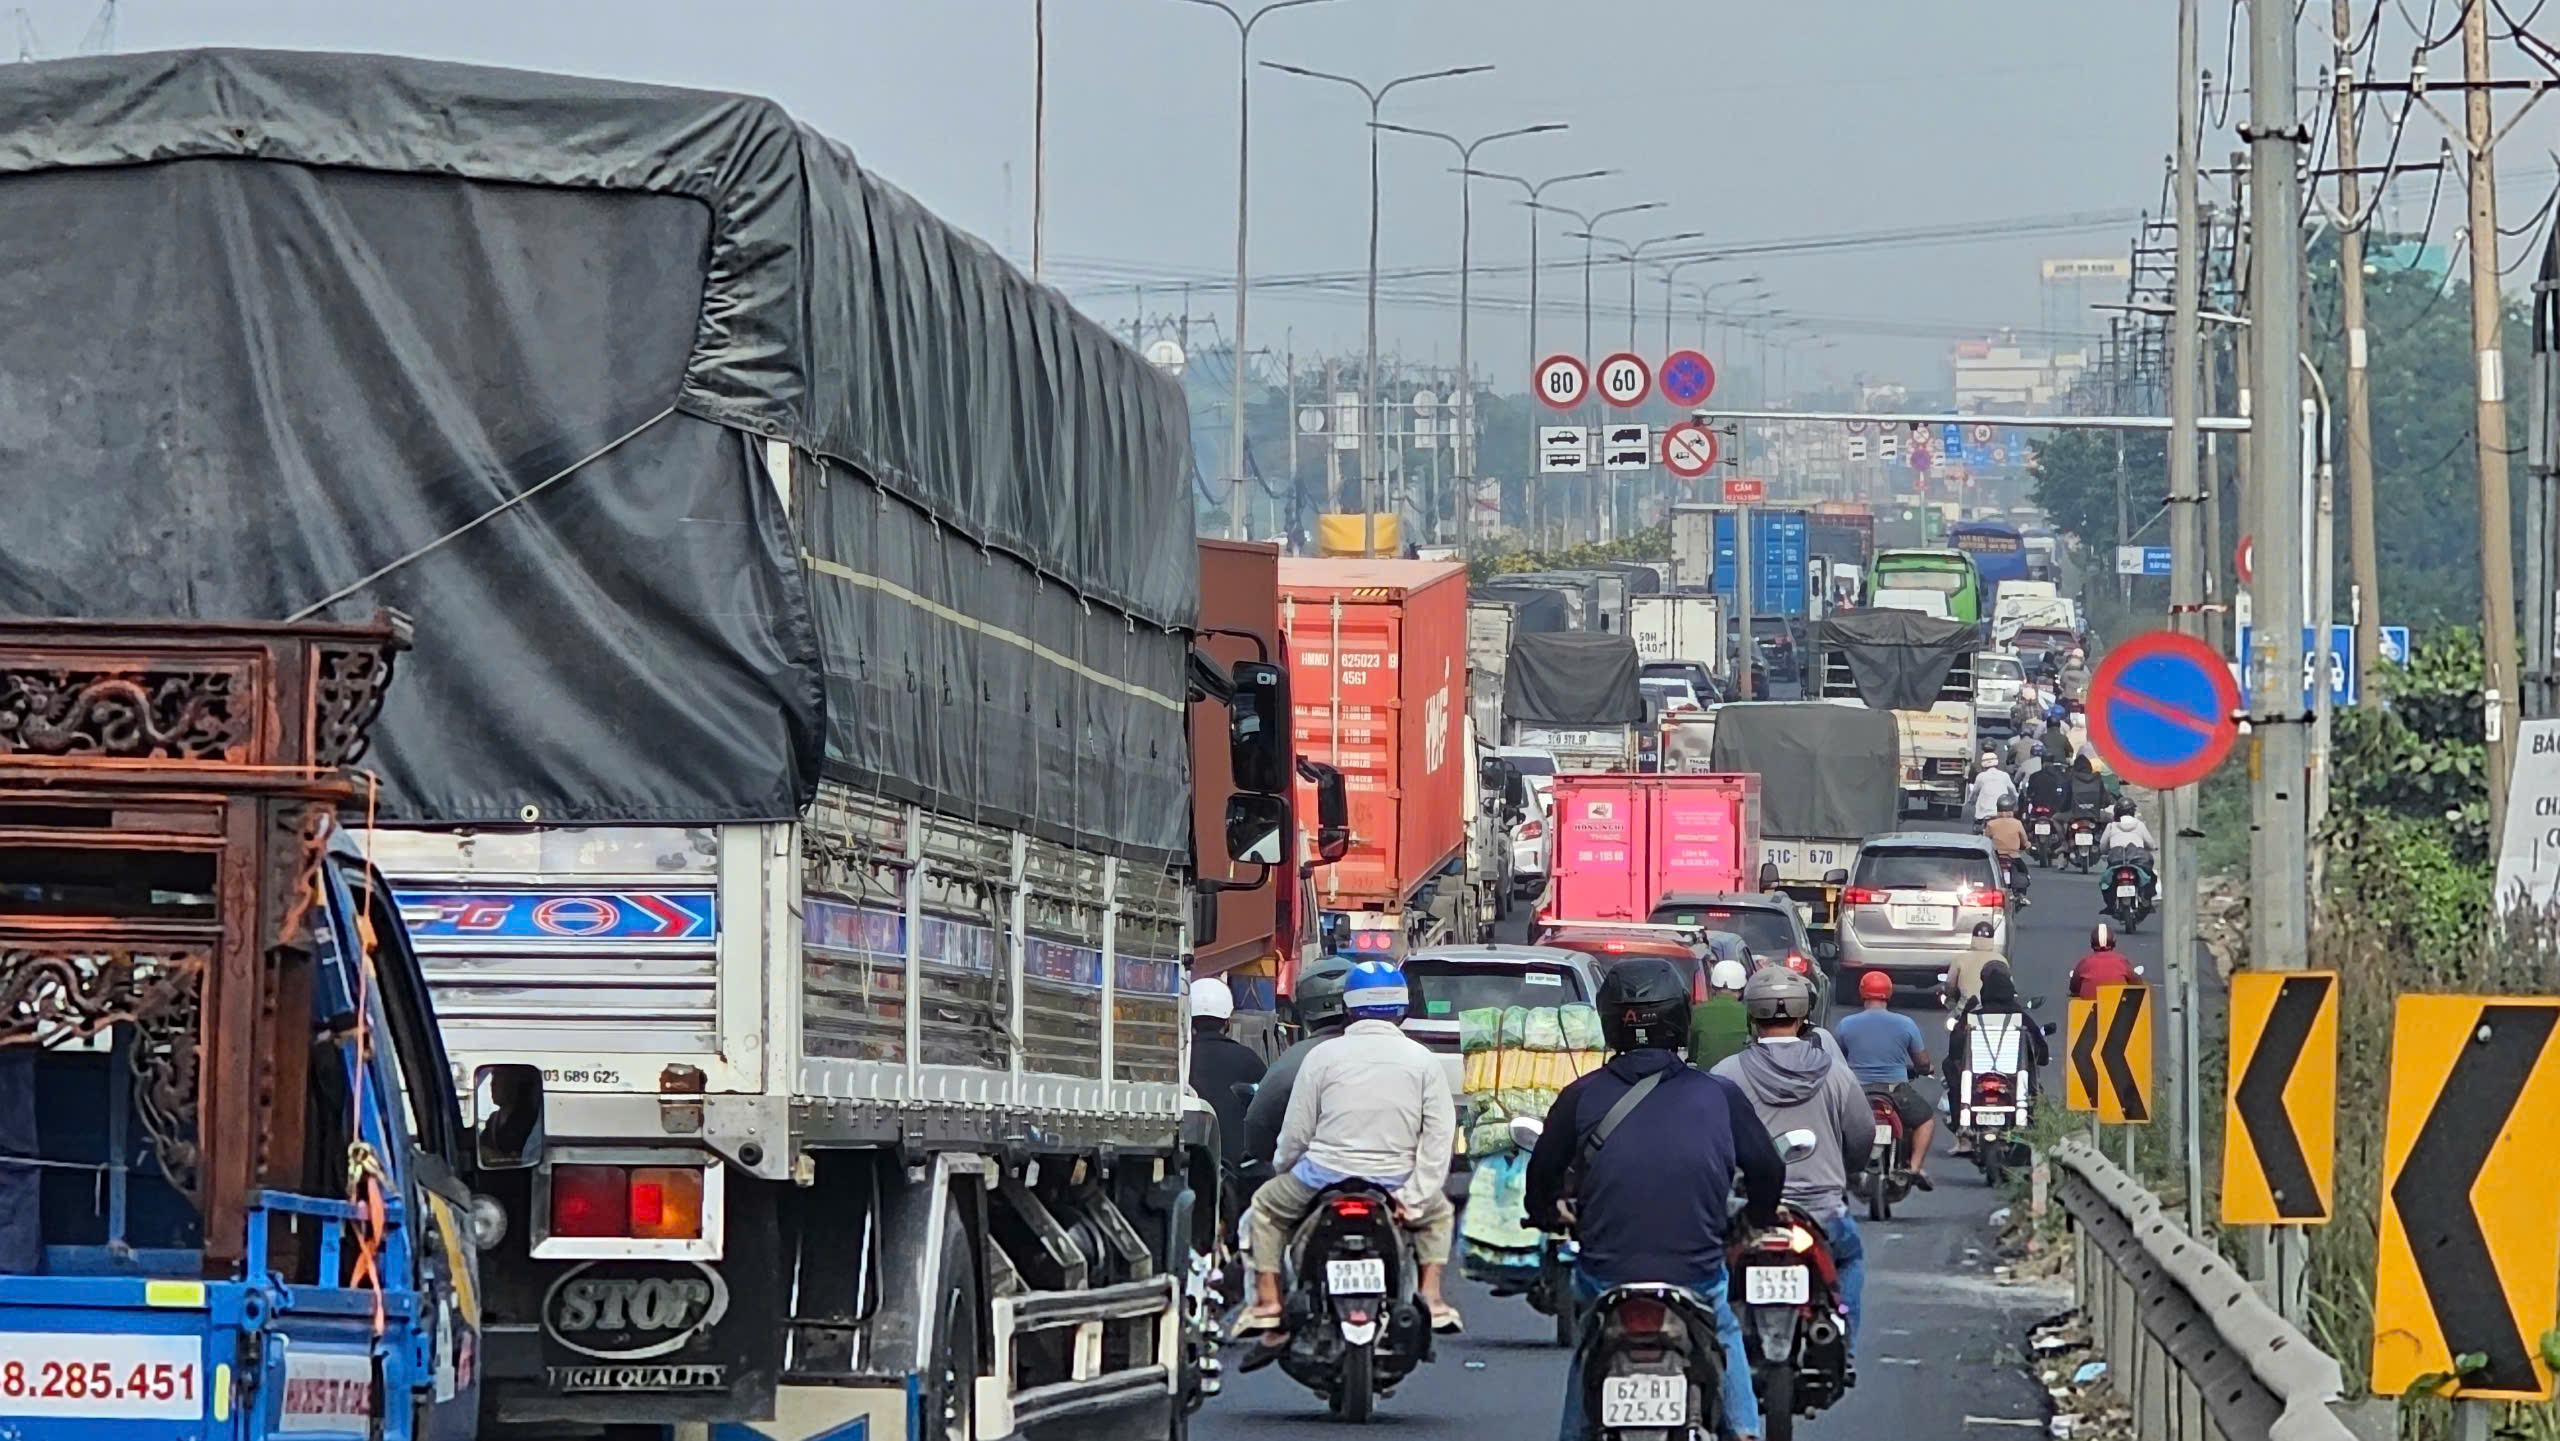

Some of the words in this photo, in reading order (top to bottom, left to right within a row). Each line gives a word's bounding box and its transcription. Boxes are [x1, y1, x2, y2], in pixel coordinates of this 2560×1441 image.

[1550, 371, 1574, 394] 80
[1612, 369, 1636, 392] 60
[1301, 652, 1329, 667] HMMU
[1341, 653, 1380, 668] 625023
[1809, 849, 1833, 865] 670
[563, 1070, 589, 1083] 689
[593, 1070, 620, 1084] 625
[560, 1278, 711, 1331] STOP
[615, 1364, 728, 1390] QUALITY
